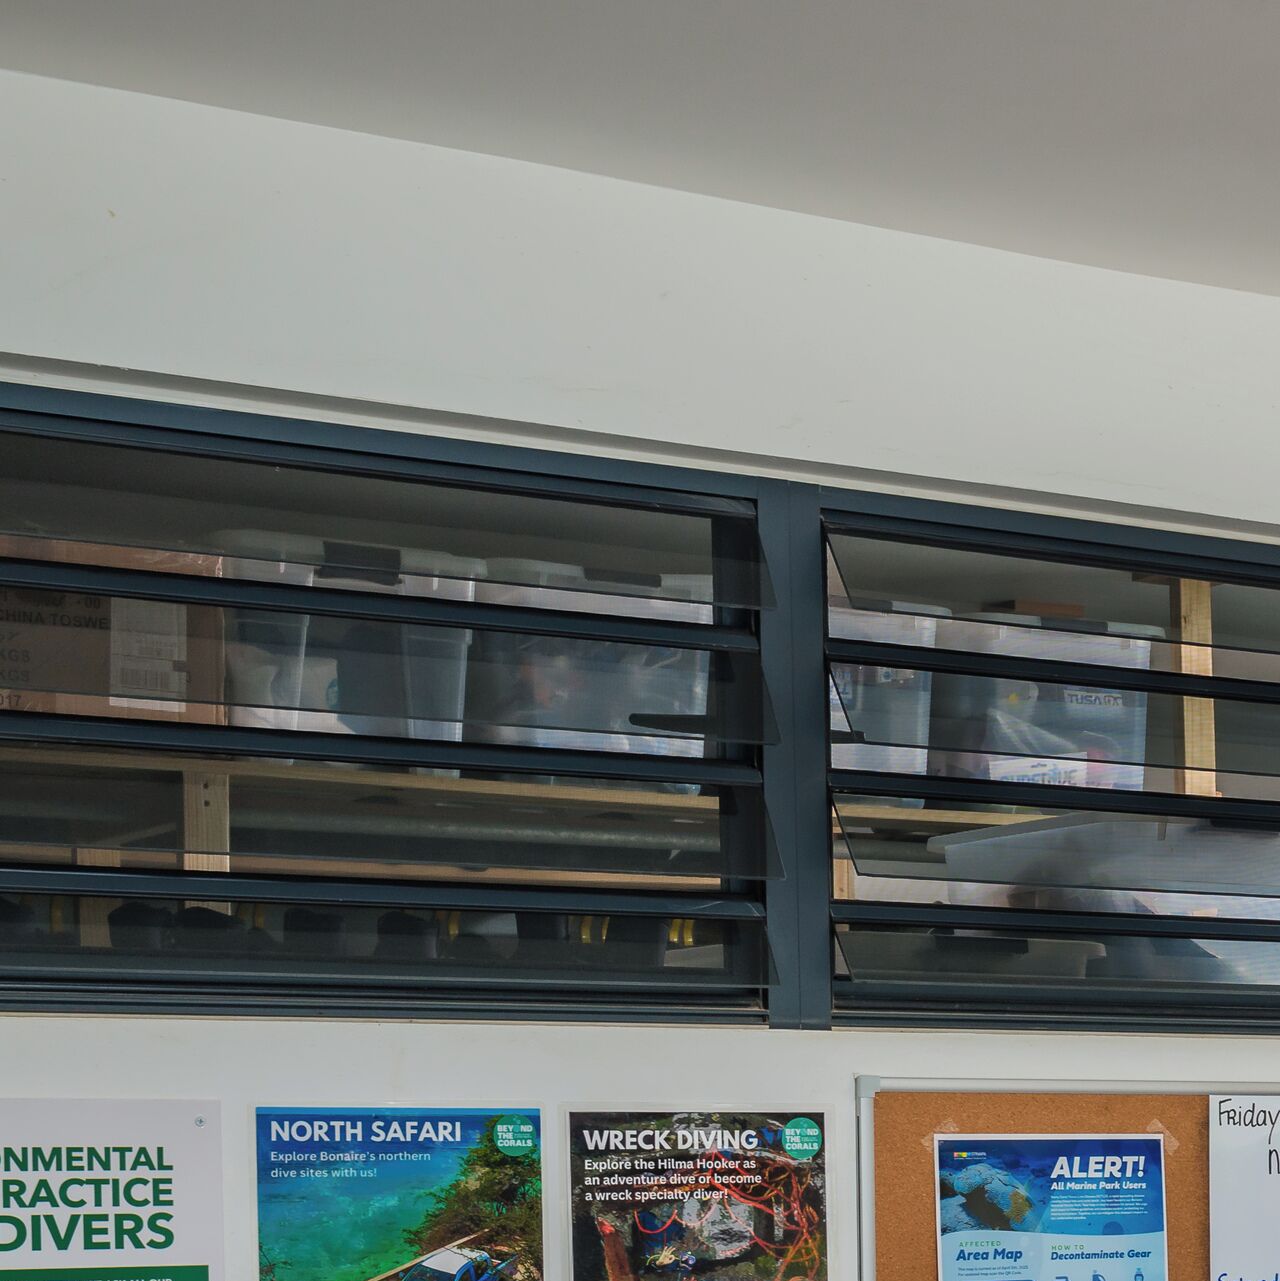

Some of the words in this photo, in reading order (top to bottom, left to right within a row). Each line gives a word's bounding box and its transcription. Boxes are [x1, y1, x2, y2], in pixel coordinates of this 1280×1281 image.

[1218, 1098, 1280, 1145] Friday
[270, 1120, 362, 1142] NORTH
[371, 1120, 462, 1142] SAFARI
[497, 1140, 532, 1148] CORALS
[584, 1130, 670, 1150] WRECK
[677, 1129, 758, 1150] DIVING
[0, 1146, 173, 1172] NMENTAL
[270, 1152, 316, 1162] Explore
[379, 1152, 430, 1161] northern
[584, 1159, 632, 1172] Explore
[634, 1159, 655, 1170] the
[657, 1159, 694, 1170] Hilma
[697, 1158, 740, 1170] Hooker
[743, 1160, 756, 1169] as
[1050, 1155, 1145, 1178] ALERT!
[270, 1168, 297, 1178] dive
[300, 1168, 328, 1178] sites
[331, 1167, 357, 1178] with
[360, 1168, 377, 1178] us!
[584, 1176, 600, 1186] an
[603, 1174, 666, 1185] adventure
[670, 1173, 695, 1185] dive
[698, 1175, 711, 1184] or
[714, 1173, 762, 1184] become
[1051, 1181, 1064, 1191] All
[1066, 1181, 1097, 1191] Marine
[1099, 1181, 1121, 1190] Park
[1123, 1181, 1146, 1190] Users
[585, 1192, 594, 1201] a
[595, 1190, 632, 1201] wreck
[635, 1189, 690, 1202] specialty
[693, 1189, 728, 1200] diver!
[956, 1250, 989, 1261] Area
[993, 1249, 1023, 1262] Map
[1051, 1250, 1125, 1261] Decontaminate
[1127, 1250, 1151, 1259] Gear
